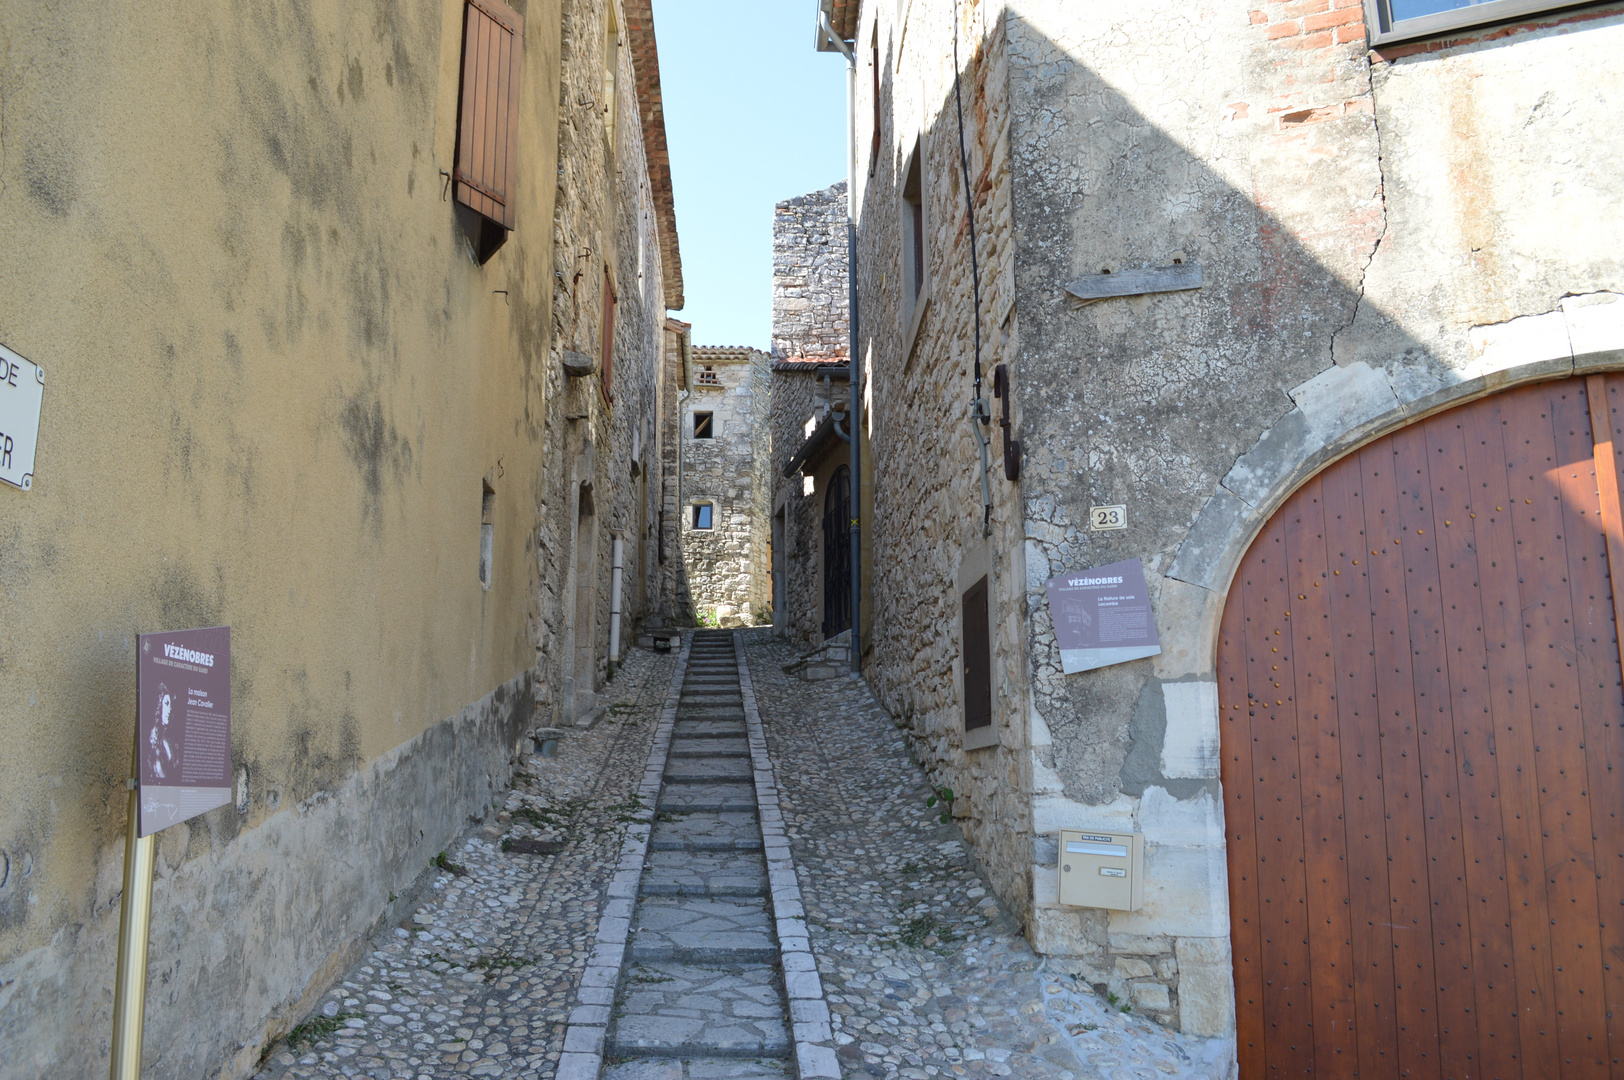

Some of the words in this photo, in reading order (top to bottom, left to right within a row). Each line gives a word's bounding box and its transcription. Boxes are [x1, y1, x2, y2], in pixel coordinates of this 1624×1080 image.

[1098, 511, 1119, 525] 23
[1068, 577, 1122, 586] VÉZÉNOBRES
[164, 642, 214, 667] VÉZÉNOBRES
[194, 689, 207, 697] maison
